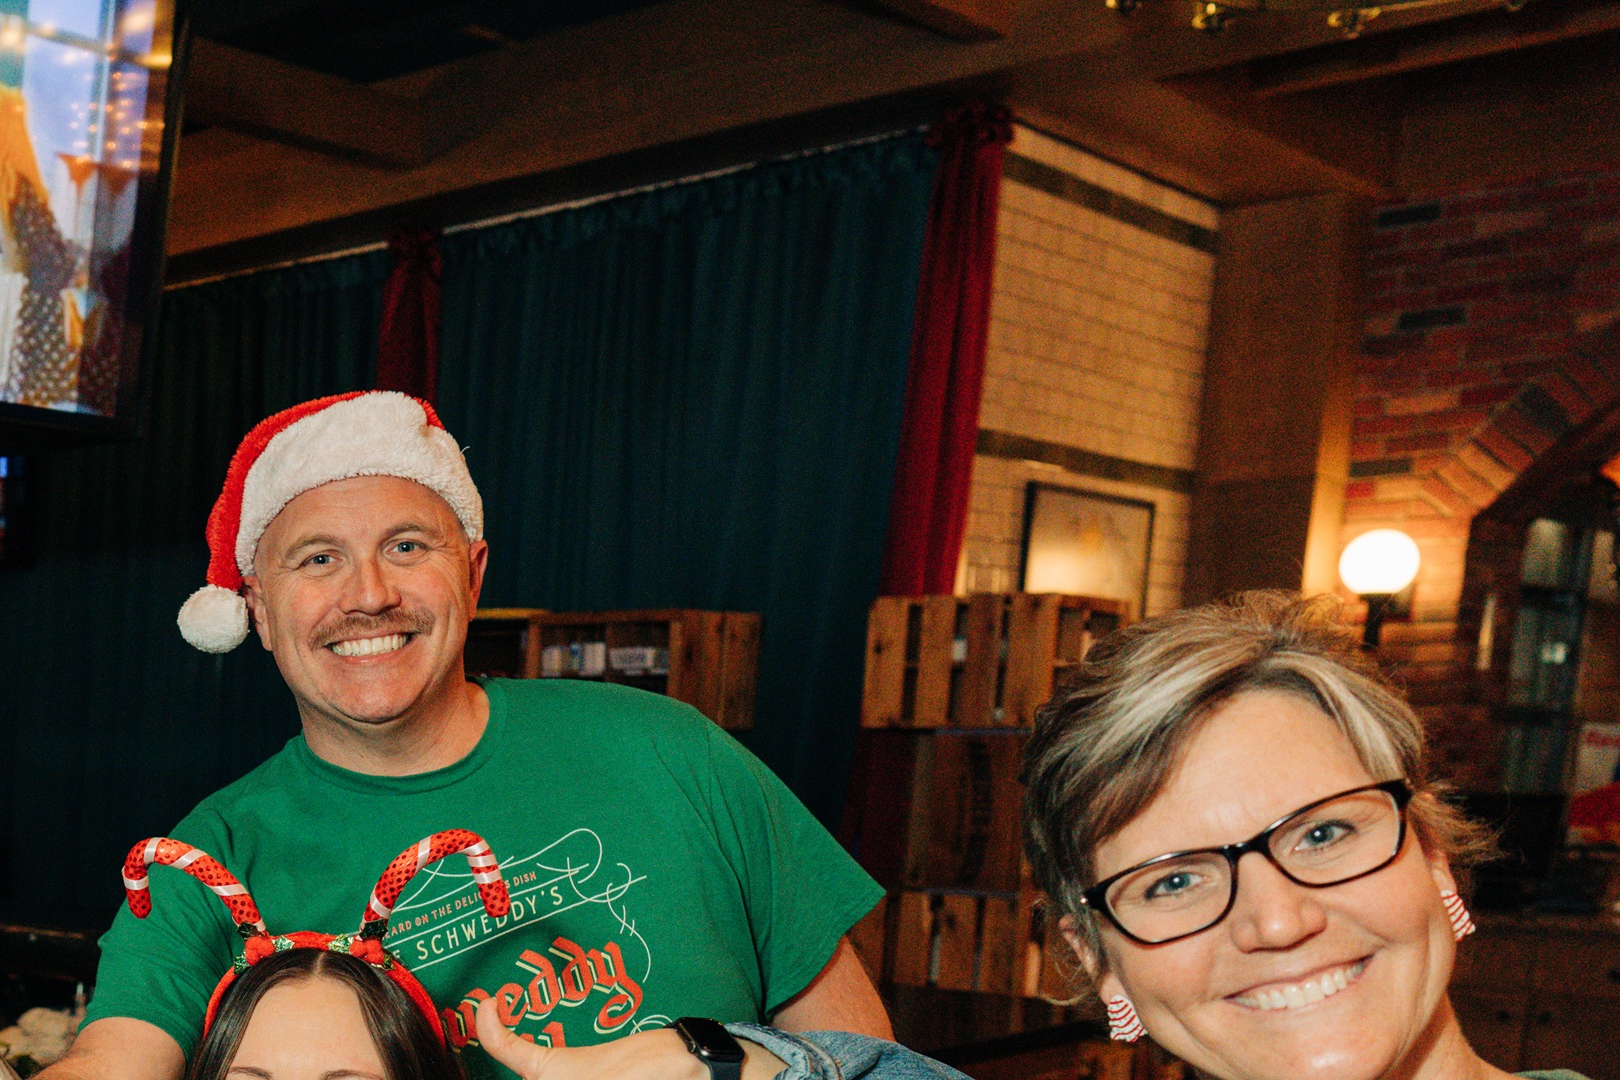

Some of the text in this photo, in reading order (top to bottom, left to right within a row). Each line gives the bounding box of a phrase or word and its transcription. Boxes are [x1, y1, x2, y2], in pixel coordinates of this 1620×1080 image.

[385, 921, 412, 940] EARD
[415, 913, 429, 927] ON
[431, 903, 453, 920] THE
[513, 871, 537, 887] DISH
